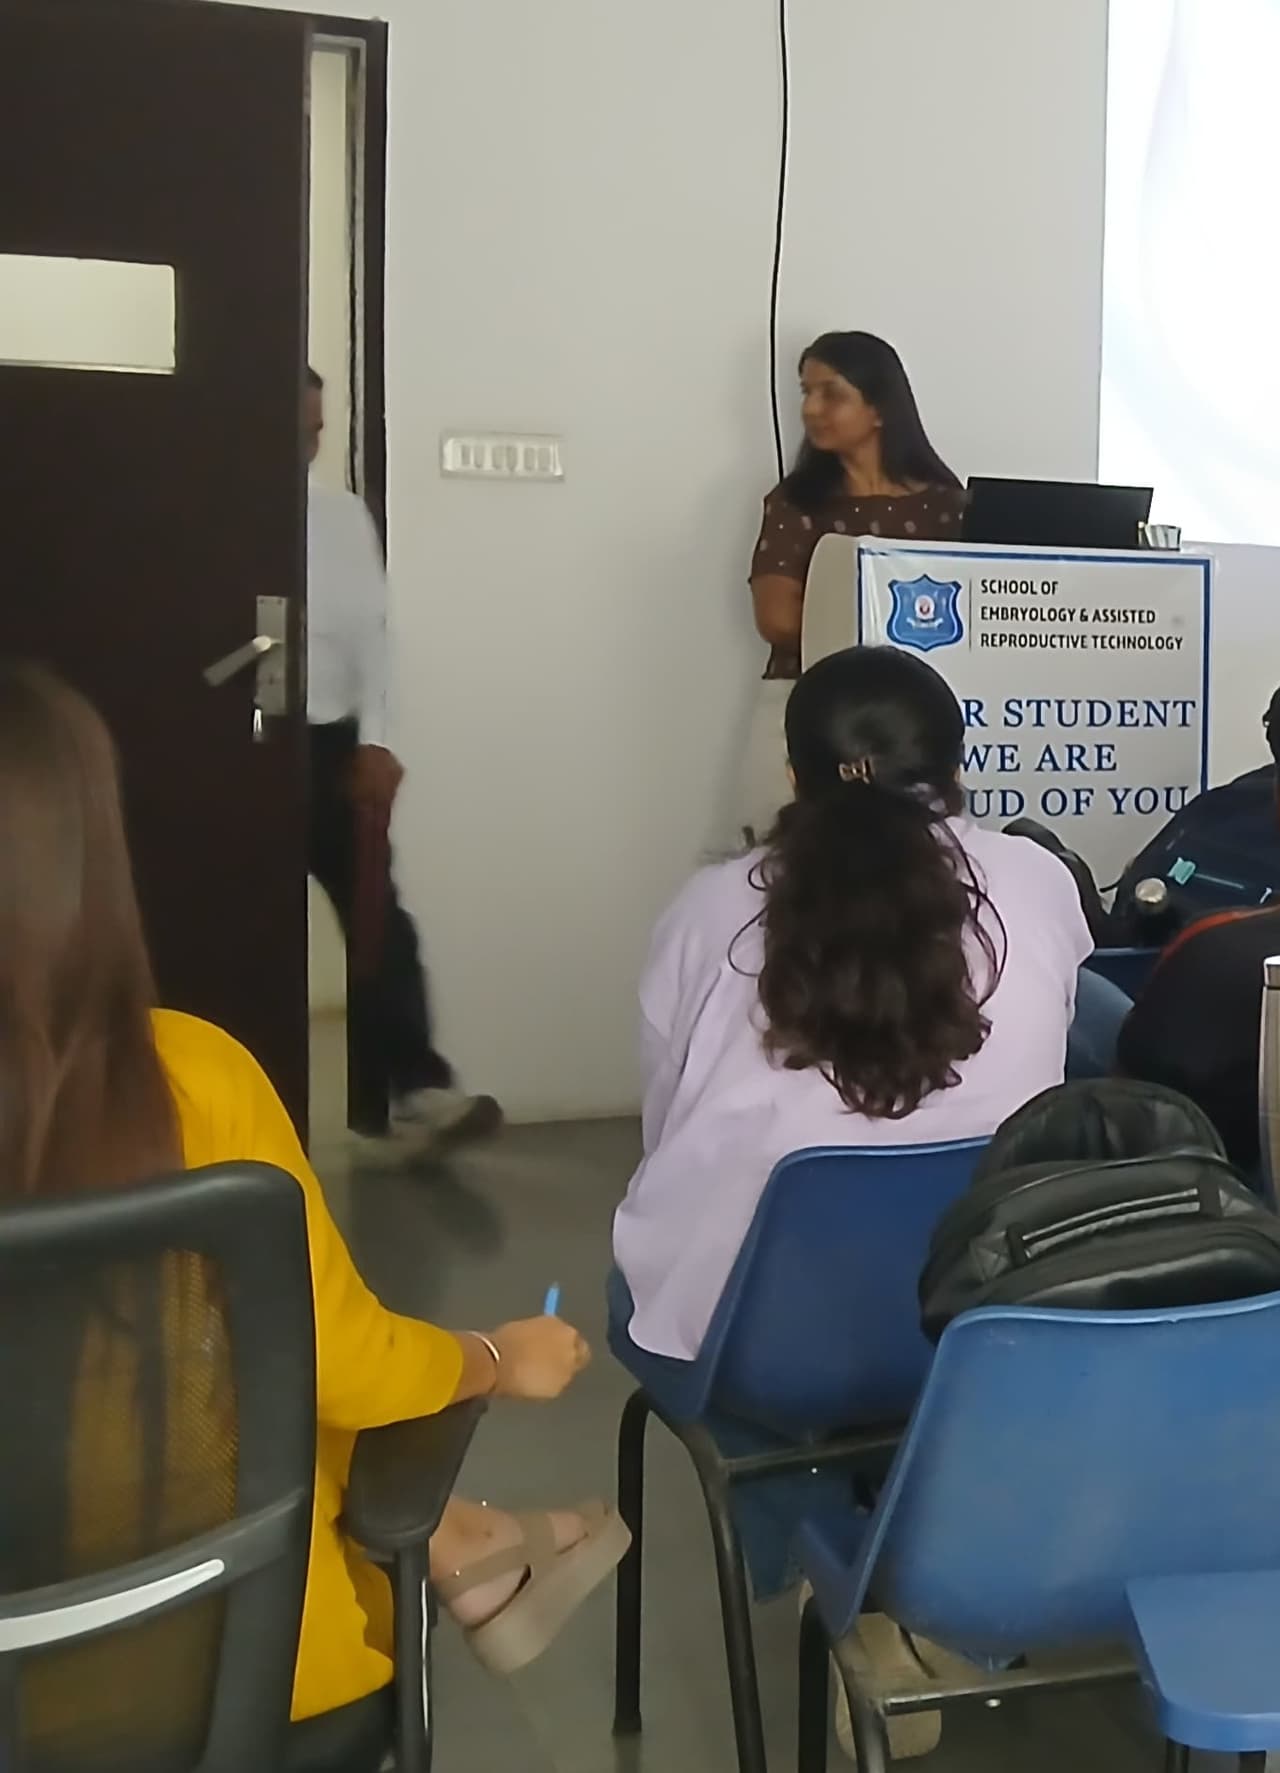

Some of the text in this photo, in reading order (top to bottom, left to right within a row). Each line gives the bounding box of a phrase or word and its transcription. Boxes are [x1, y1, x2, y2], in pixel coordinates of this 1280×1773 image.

[980, 578, 1059, 596] SCHOOL OF
[980, 605, 1156, 624] EMBRYOLOGY & ASSISTED
[980, 632, 1183, 651] REPRODUCTIVE TECHNOLOGY
[1003, 698, 1197, 728] STUDENT
[1034, 743, 1117, 772] ARE
[1040, 787, 1095, 817] OF
[1107, 785, 1190, 815] YOU
